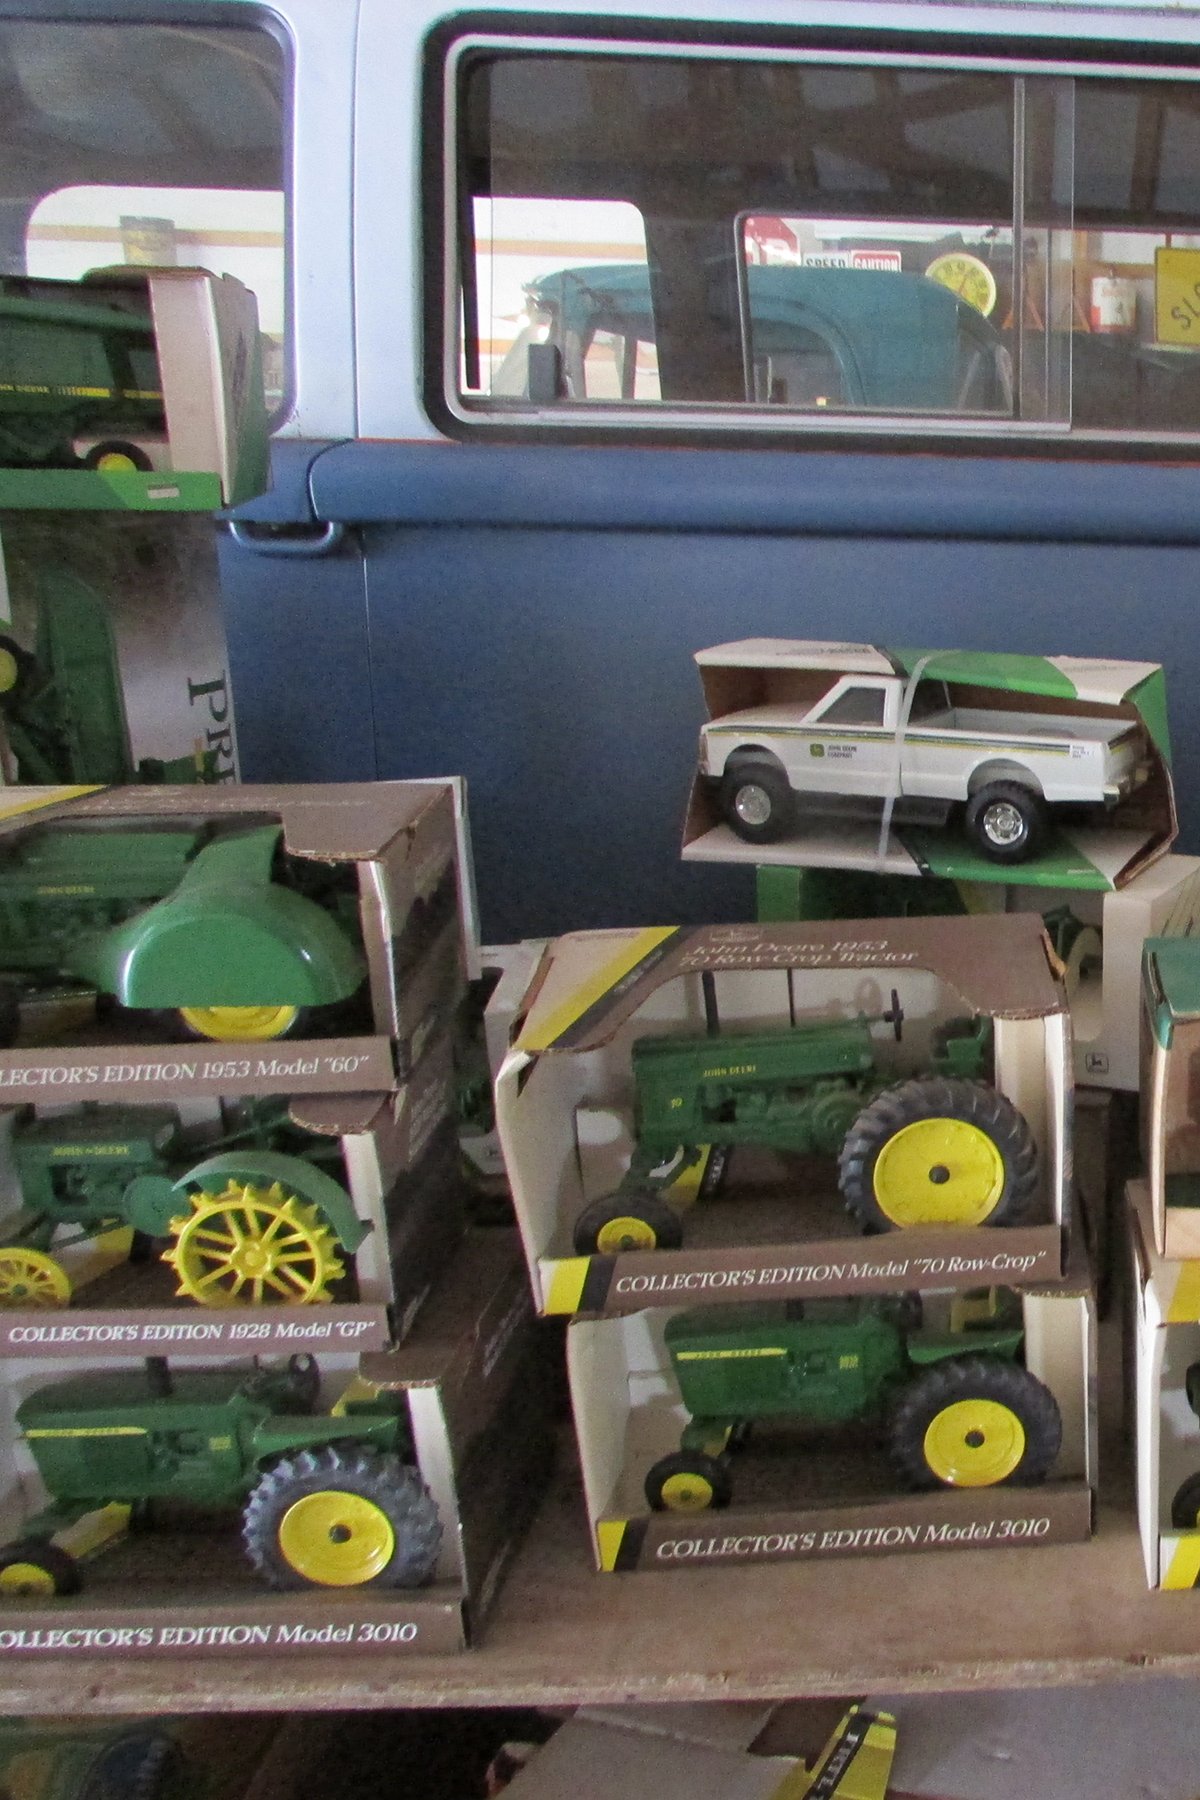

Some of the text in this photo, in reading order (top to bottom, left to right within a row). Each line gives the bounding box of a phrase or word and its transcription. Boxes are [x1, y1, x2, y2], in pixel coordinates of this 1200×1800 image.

[102, 1062, 199, 1083] EDITION
[202, 1059, 251, 1080] 1953
[255, 1056, 320, 1077] Model
[616, 1269, 756, 1294] COLLECTOR'S
[757, 1264, 849, 1286] EDITION
[847, 1259, 911, 1280] Model
[8, 1325, 140, 1344] COLLECTOR'S
[142, 1324, 224, 1342] EDITION
[229, 1323, 271, 1341] 1928
[275, 1321, 333, 1339] Model
[656, 1516, 1051, 1561] COLLECTOR'S EDITION Model 3010
[0, 1622, 419, 1649] OLLECTOR'S EDITION Model 3010
